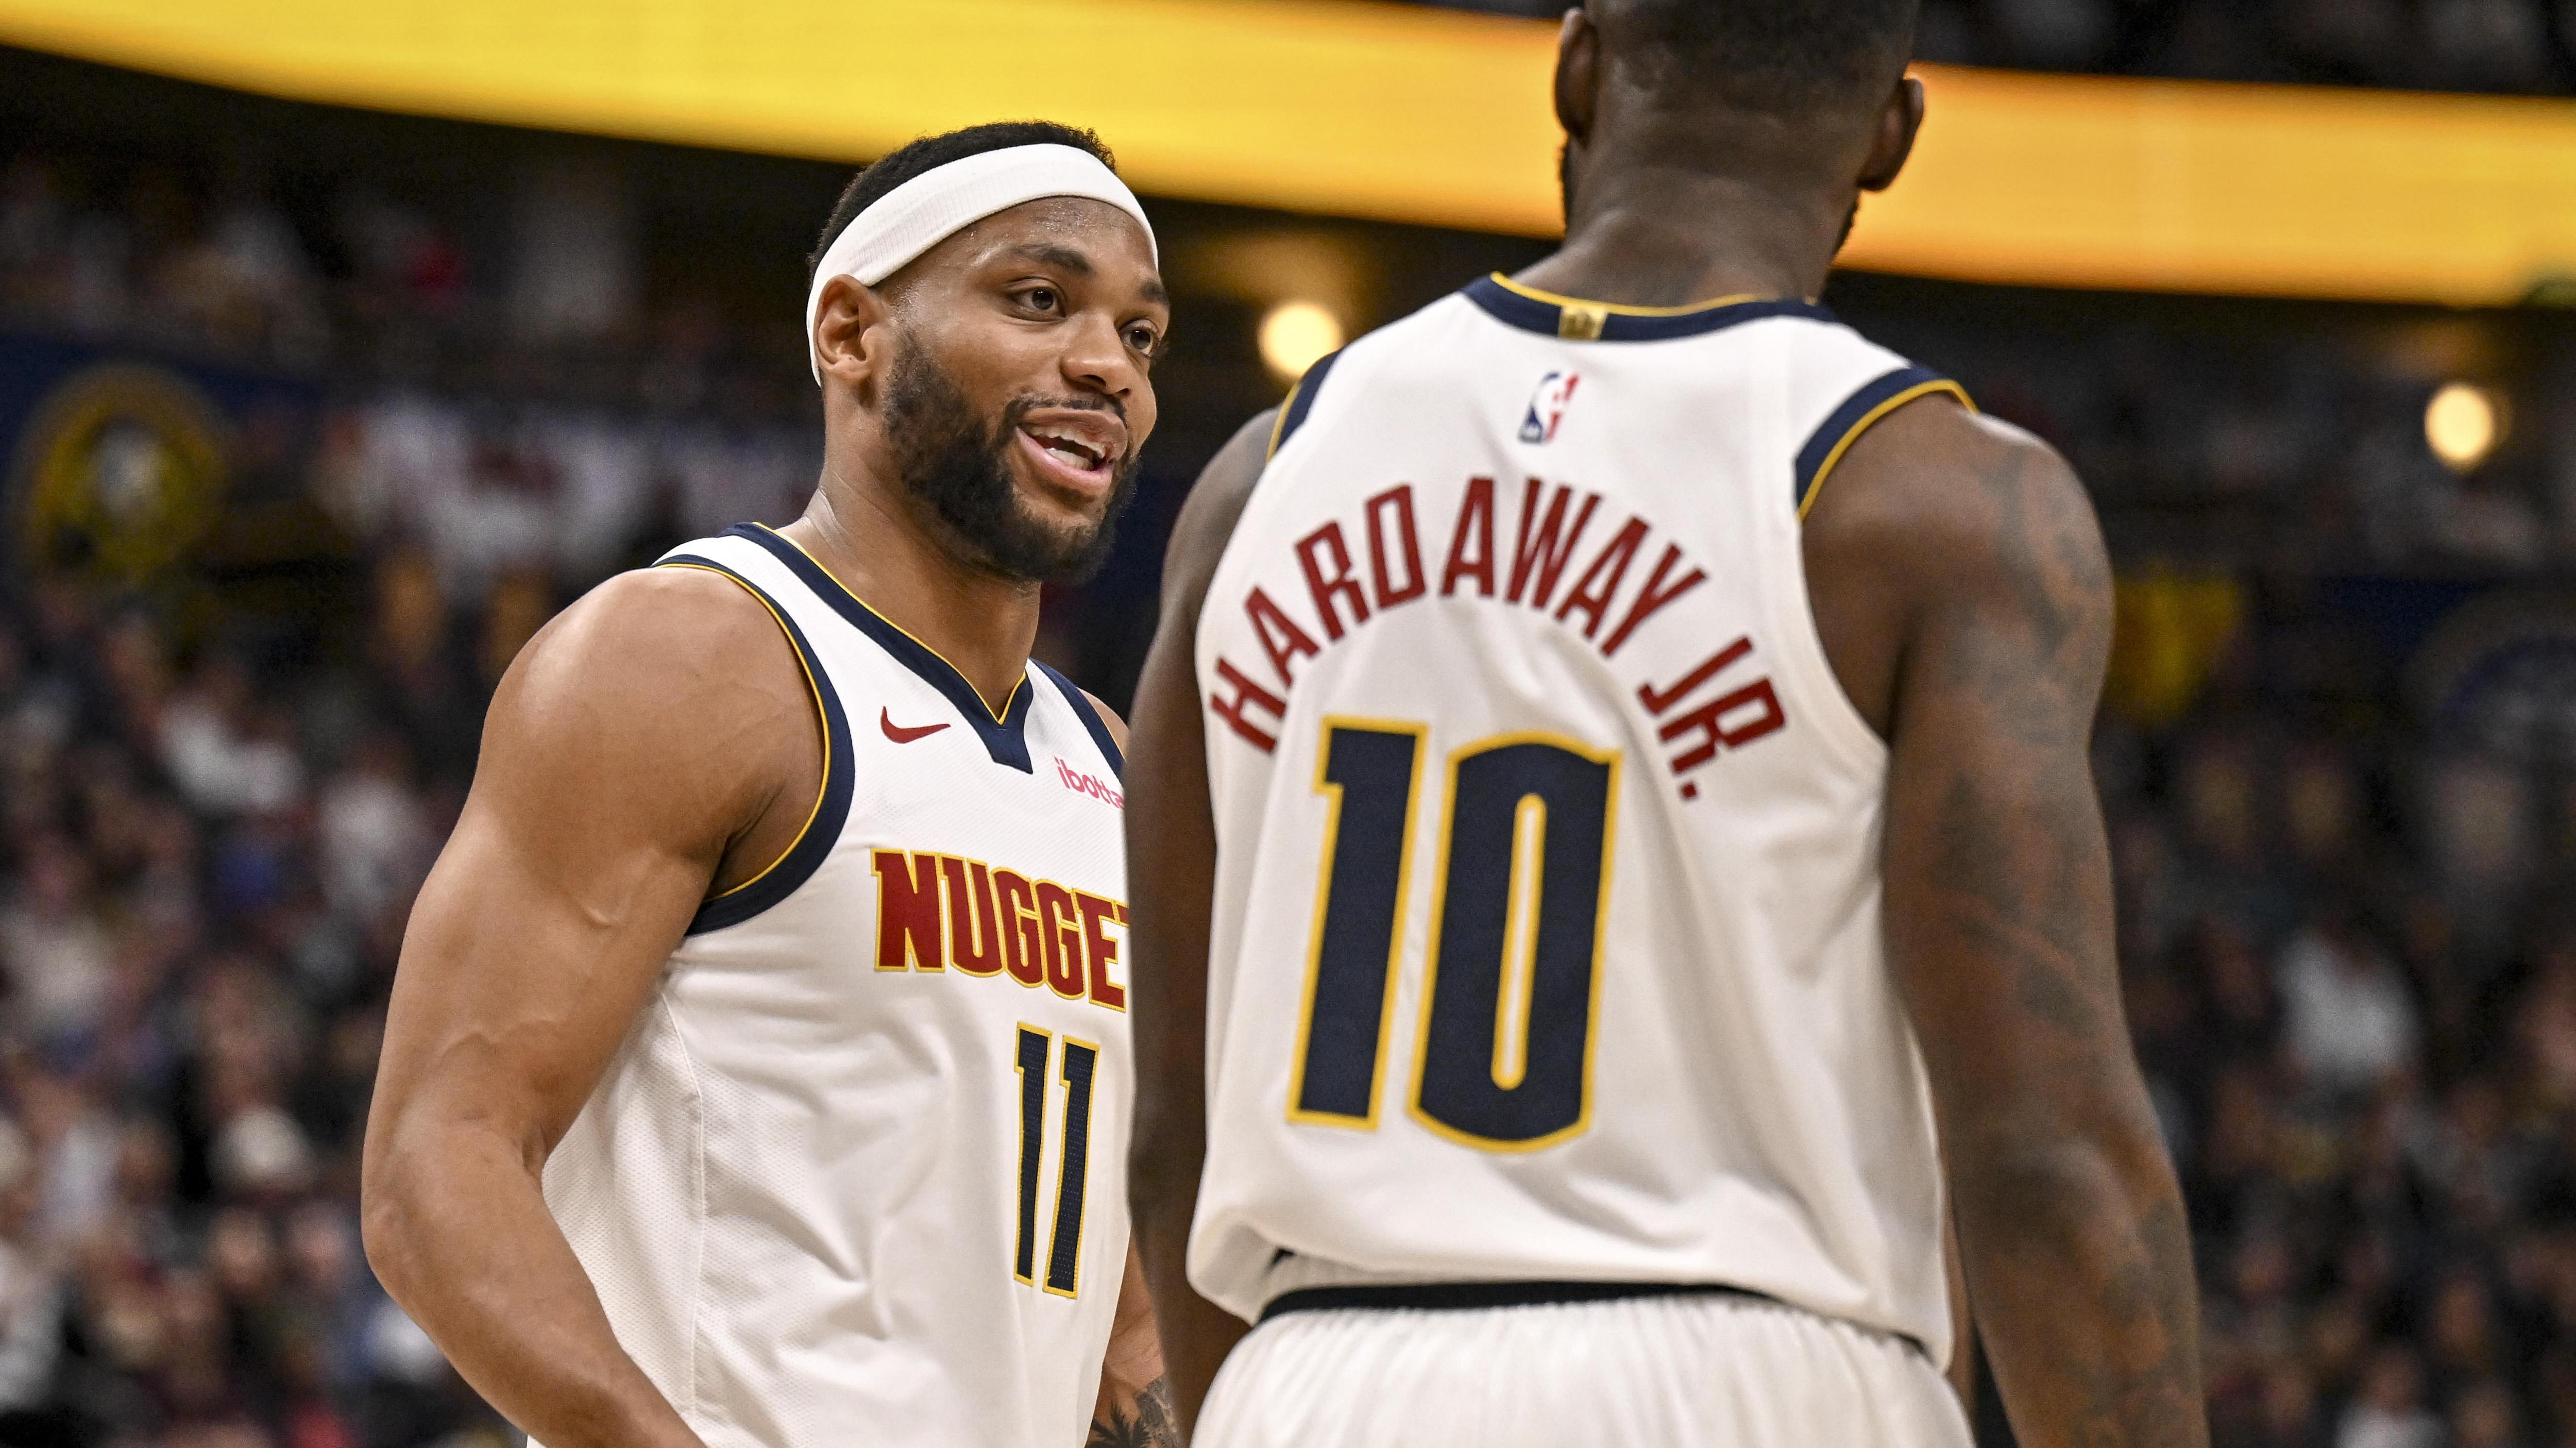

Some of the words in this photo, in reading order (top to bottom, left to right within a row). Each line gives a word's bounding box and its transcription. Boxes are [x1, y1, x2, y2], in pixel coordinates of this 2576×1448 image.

[1210, 477, 1706, 753] HARDAWAY
[1638, 636, 1785, 799] JR.
[871, 848, 1130, 1013] NUGGE
[1286, 715, 1623, 1154] 10
[1013, 1021, 1100, 1299] 11
